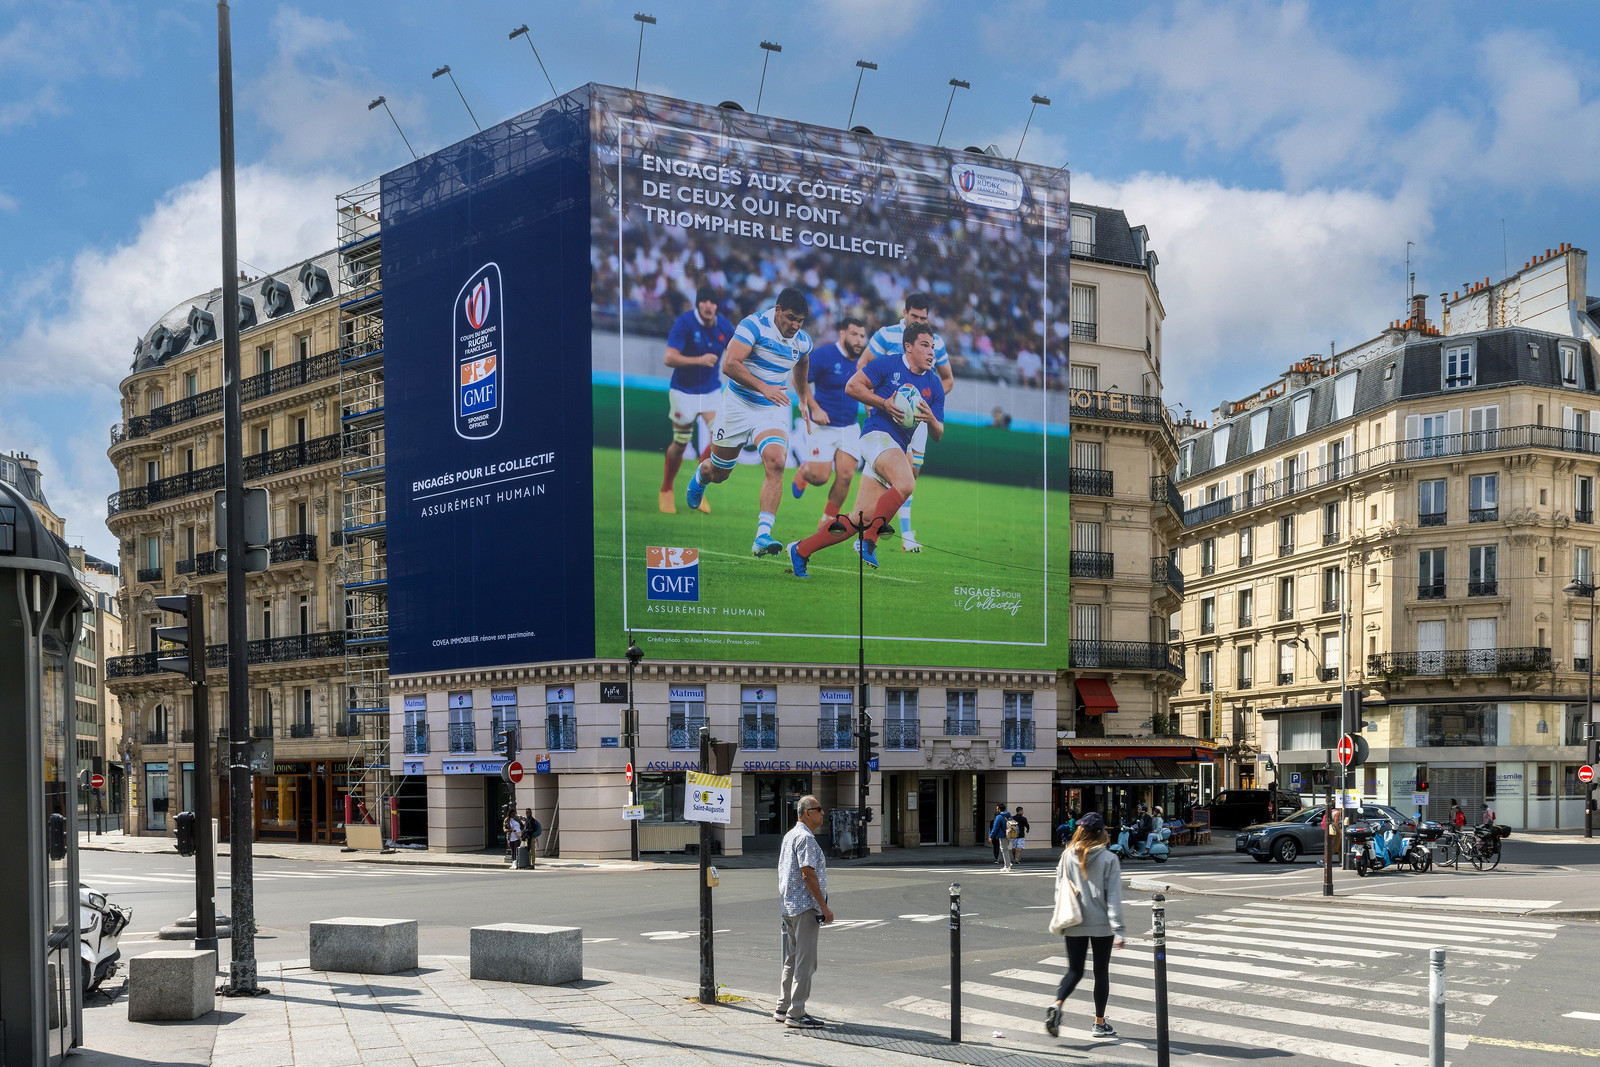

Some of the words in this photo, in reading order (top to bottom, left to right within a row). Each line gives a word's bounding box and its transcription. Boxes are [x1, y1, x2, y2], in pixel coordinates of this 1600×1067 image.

[642, 154, 742, 185] ENGAGÉS
[747, 172, 792, 194] AUX
[798, 179, 862, 205] CÔTÉS
[977, 180, 1000, 189] RUGBY
[977, 186, 996, 194] FRANCE
[642, 180, 670, 200] DE
[677, 186, 736, 210] CEUX
[742, 196, 779, 216] QUI
[786, 202, 840, 225] FONT
[642, 205, 765, 239] TRIOMPHER
[771, 225, 793, 243] LE
[798, 230, 908, 260] COLLECTIF.
[460, 333, 474, 342] COUPE
[481, 326, 496, 335] MONDE
[468, 334, 488, 348] RUGBY
[465, 345, 481, 355] FRANCE
[482, 342, 492, 350] 2023
[464, 384, 493, 407] GMF
[468, 414, 489, 424] SPONSOR
[469, 421, 488, 429] OFFICIEL
[717, 428, 724, 440] 6
[412, 472, 454, 492] ENGAGÉS
[456, 468, 483, 483] POUR
[485, 464, 496, 476] LE
[498, 452, 555, 473] COLLECTIF
[421, 494, 491, 518] ASSURÉMENT
[497, 484, 545, 502] HUMAIN
[651, 575, 695, 594] GMF
[954, 587, 1000, 597] ENGAGÉS
[647, 605, 717, 614] ASSURÉMENT
[723, 608, 765, 616] HUMAIN
[964, 595, 1022, 616] Collectif
[450, 636, 479, 644] IMMOBILIER
[507, 631, 535, 640] patrimoine.
[744, 761, 791, 771] SERVICES
[796, 760, 858, 770] FINANCIERS
[693, 804, 724, 813] Saint-Augustin
